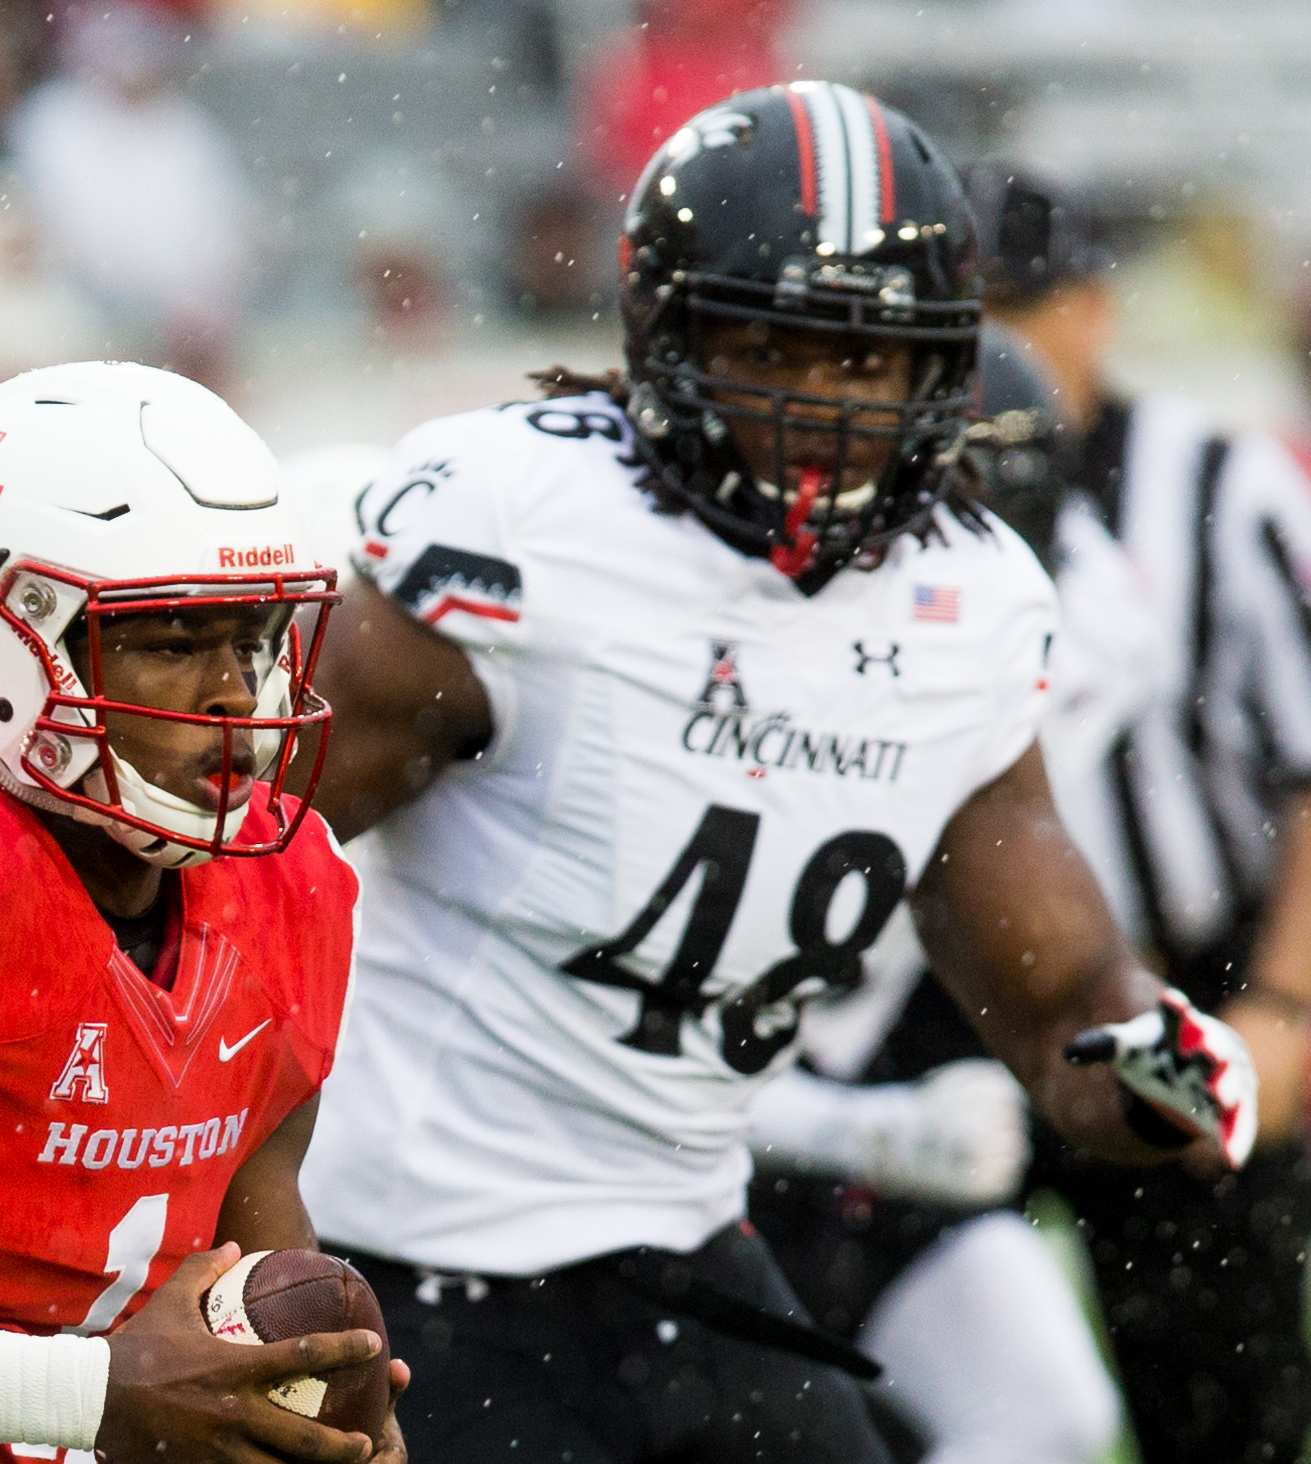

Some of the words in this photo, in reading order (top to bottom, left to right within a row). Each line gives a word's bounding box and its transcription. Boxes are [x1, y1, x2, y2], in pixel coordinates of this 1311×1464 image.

[218, 544, 294, 567] Riddell
[682, 711, 907, 781] CINCINNATI
[558, 803, 907, 1074] 48
[49, 1022, 109, 1104] A
[37, 1107, 249, 1170] HOUSTON
[60, 1193, 170, 1338] 1
